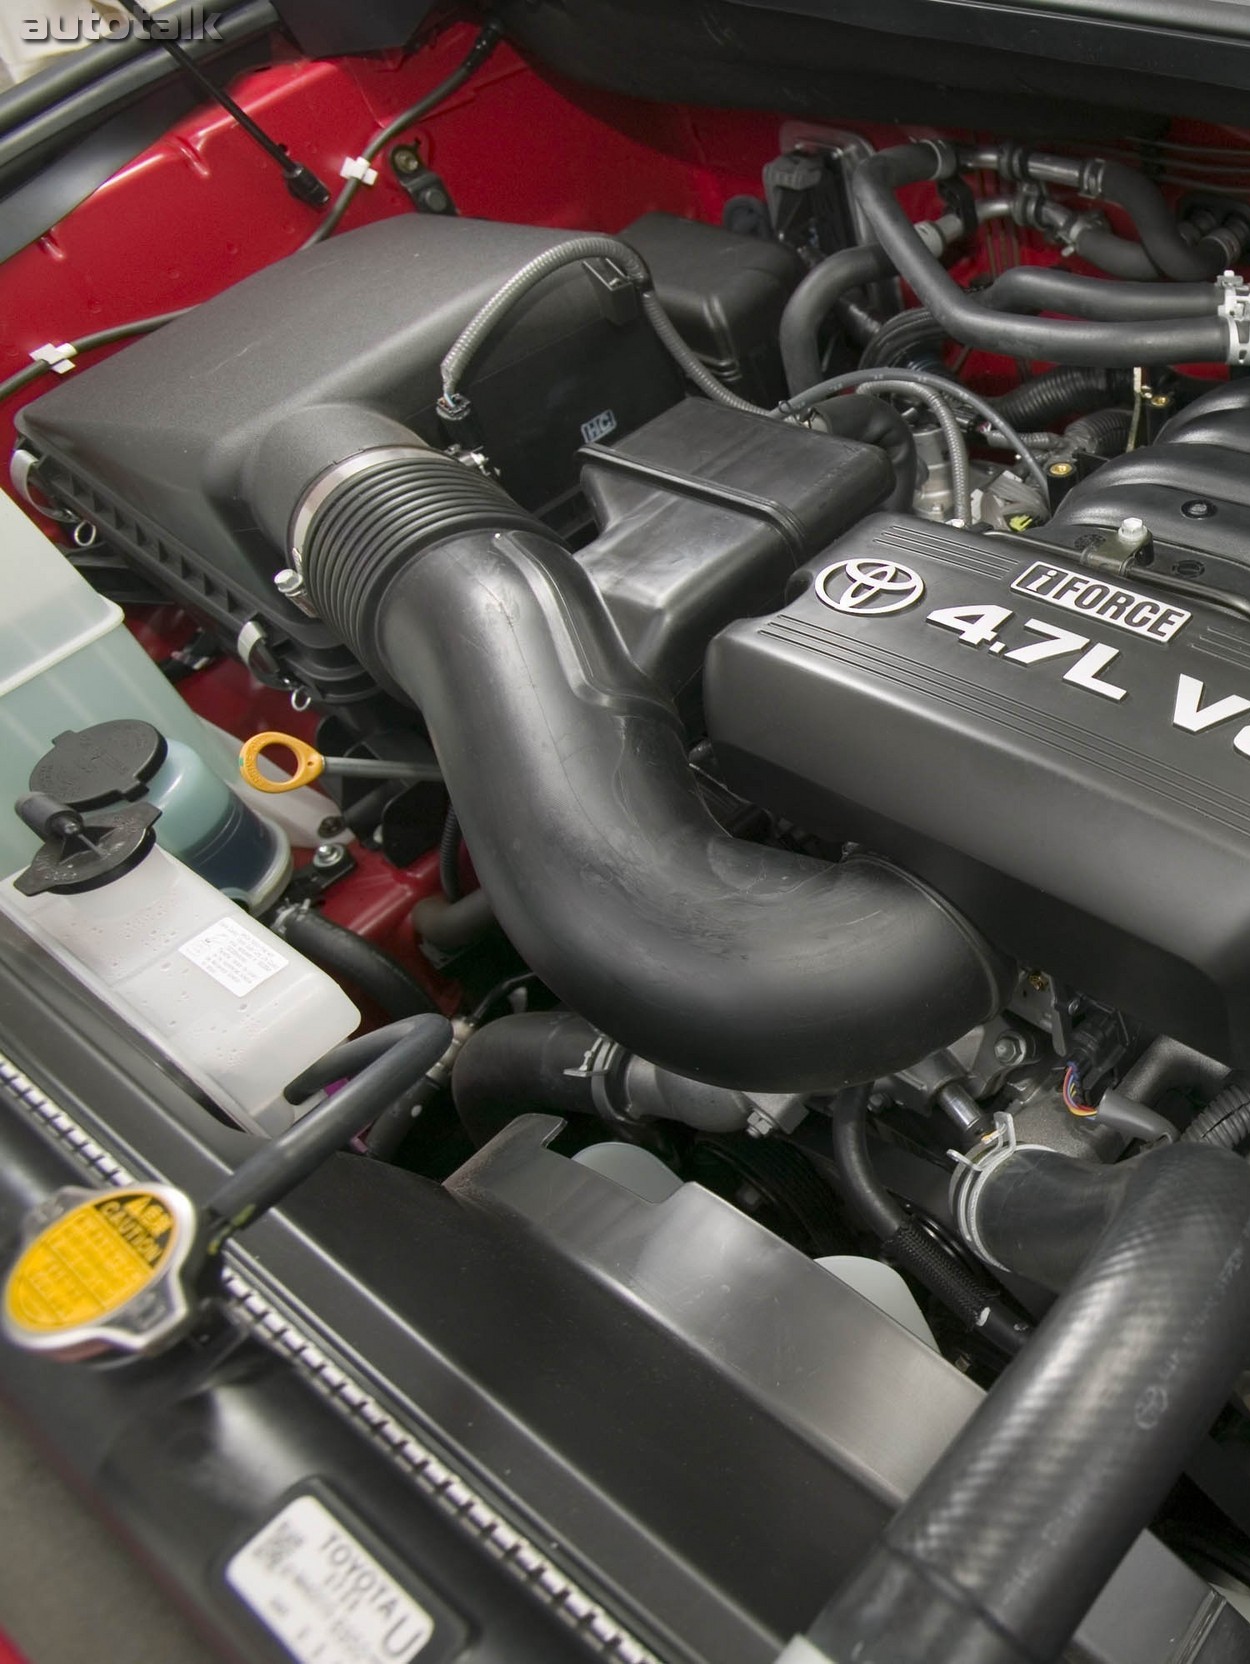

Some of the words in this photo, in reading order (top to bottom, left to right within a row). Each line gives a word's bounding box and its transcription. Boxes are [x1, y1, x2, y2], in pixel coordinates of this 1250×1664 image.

[925, 604, 1128, 703] 4.7L
[100, 1200, 163, 1262] CAUTION
[320, 1532, 398, 1620] TOYOTA
